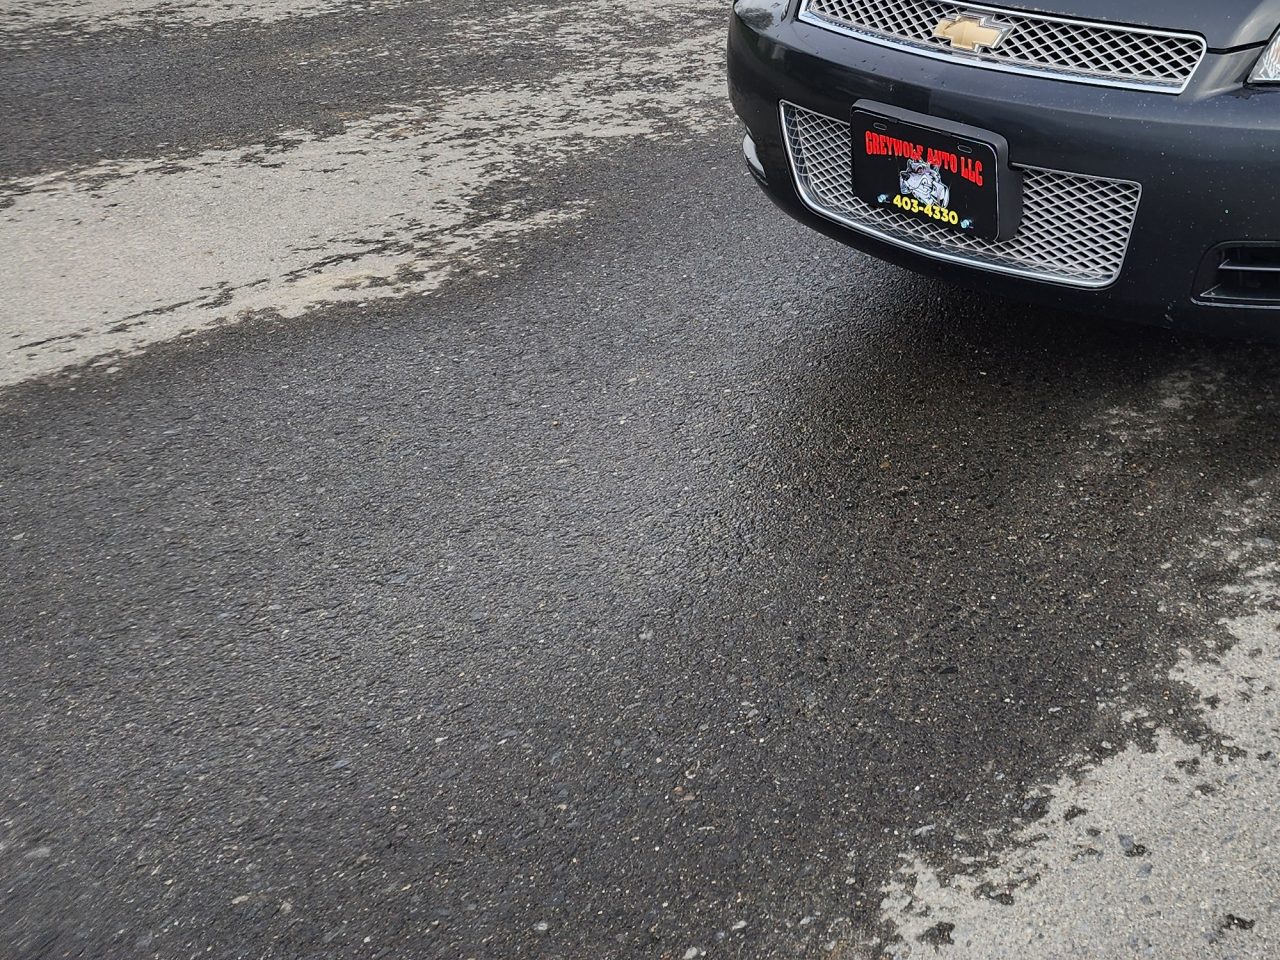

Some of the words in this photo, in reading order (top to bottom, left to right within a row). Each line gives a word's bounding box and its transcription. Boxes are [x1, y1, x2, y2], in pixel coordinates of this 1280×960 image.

[865, 130, 923, 161] GREYWOLF
[926, 147, 958, 174] AUTO
[960, 156, 983, 187] LLC
[893, 194, 959, 225] 403-4330
